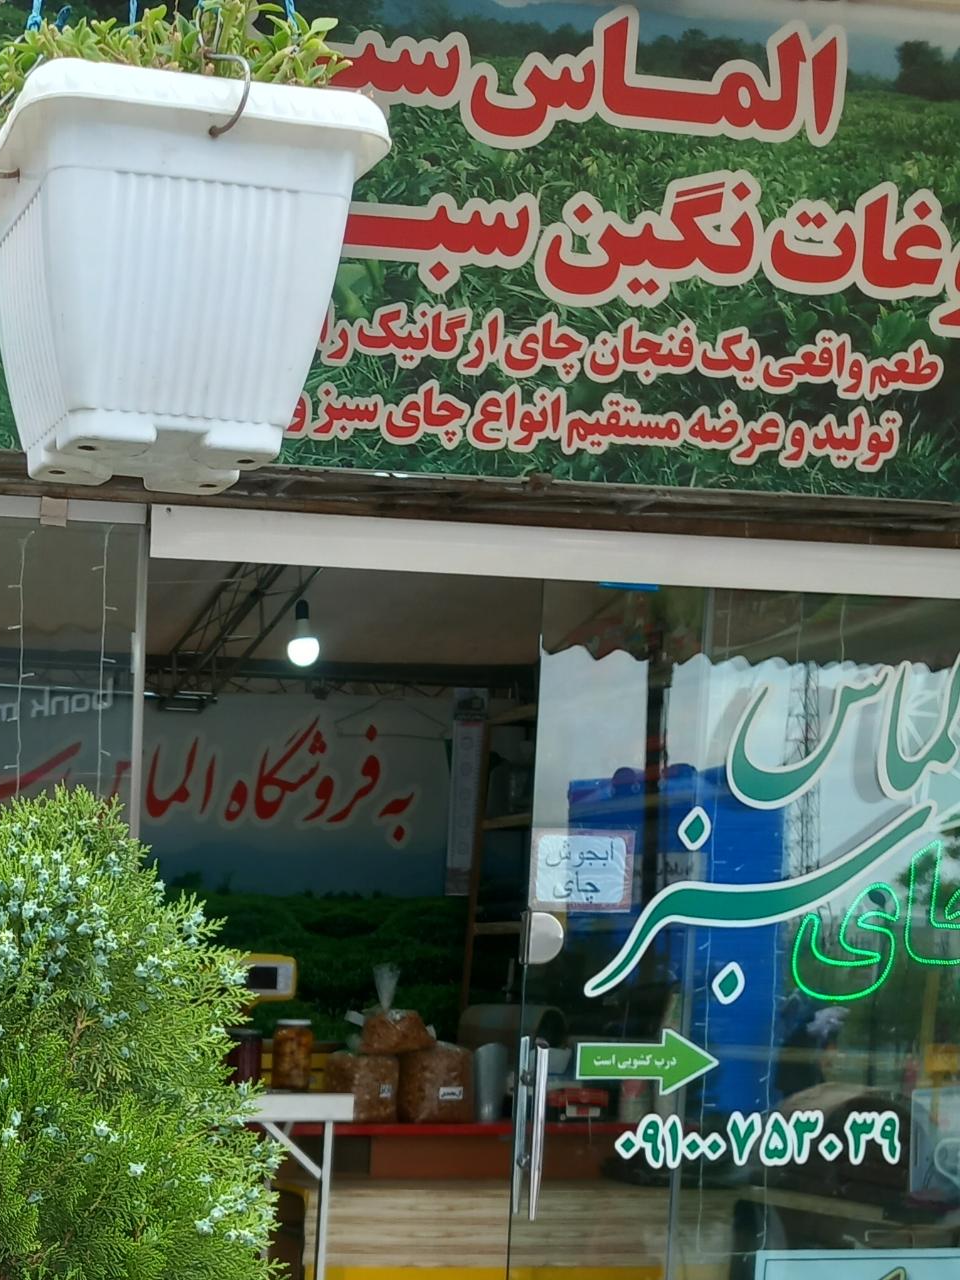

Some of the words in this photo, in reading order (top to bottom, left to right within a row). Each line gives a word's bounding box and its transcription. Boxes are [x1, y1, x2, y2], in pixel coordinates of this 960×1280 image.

[314, 42, 462, 98] سب
[468, 14, 839, 139] الماس
[344, 203, 531, 284] سب
[543, 180, 756, 299] نگین
[503, 319, 583, 377] چای
[589, 322, 695, 379] فنجان
[701, 332, 756, 384] یک
[762, 335, 864, 393] واقعی
[868, 346, 939, 395] طعم
[313, 387, 379, 434] سبز
[385, 386, 466, 444] چای
[471, 390, 562, 446] انواع
[567, 398, 681, 449] مستقیم
[689, 404, 781, 459] عرضه
[783, 424, 805, 462] و
[811, 411, 898, 467] تولید
[222, 714, 382, 824] فروشگاه
[377, 790, 416, 843] به
[552, 871, 601, 905] چای
[584, 801, 938, 1004] سبز
[593, 1053, 616, 1067] است
[617, 1053, 653, 1070] کشویی
[654, 1055, 677, 1070] درب
[616, 1111, 901, 1167] ۰۹۱۰۰۷۵۳۰۳۹
